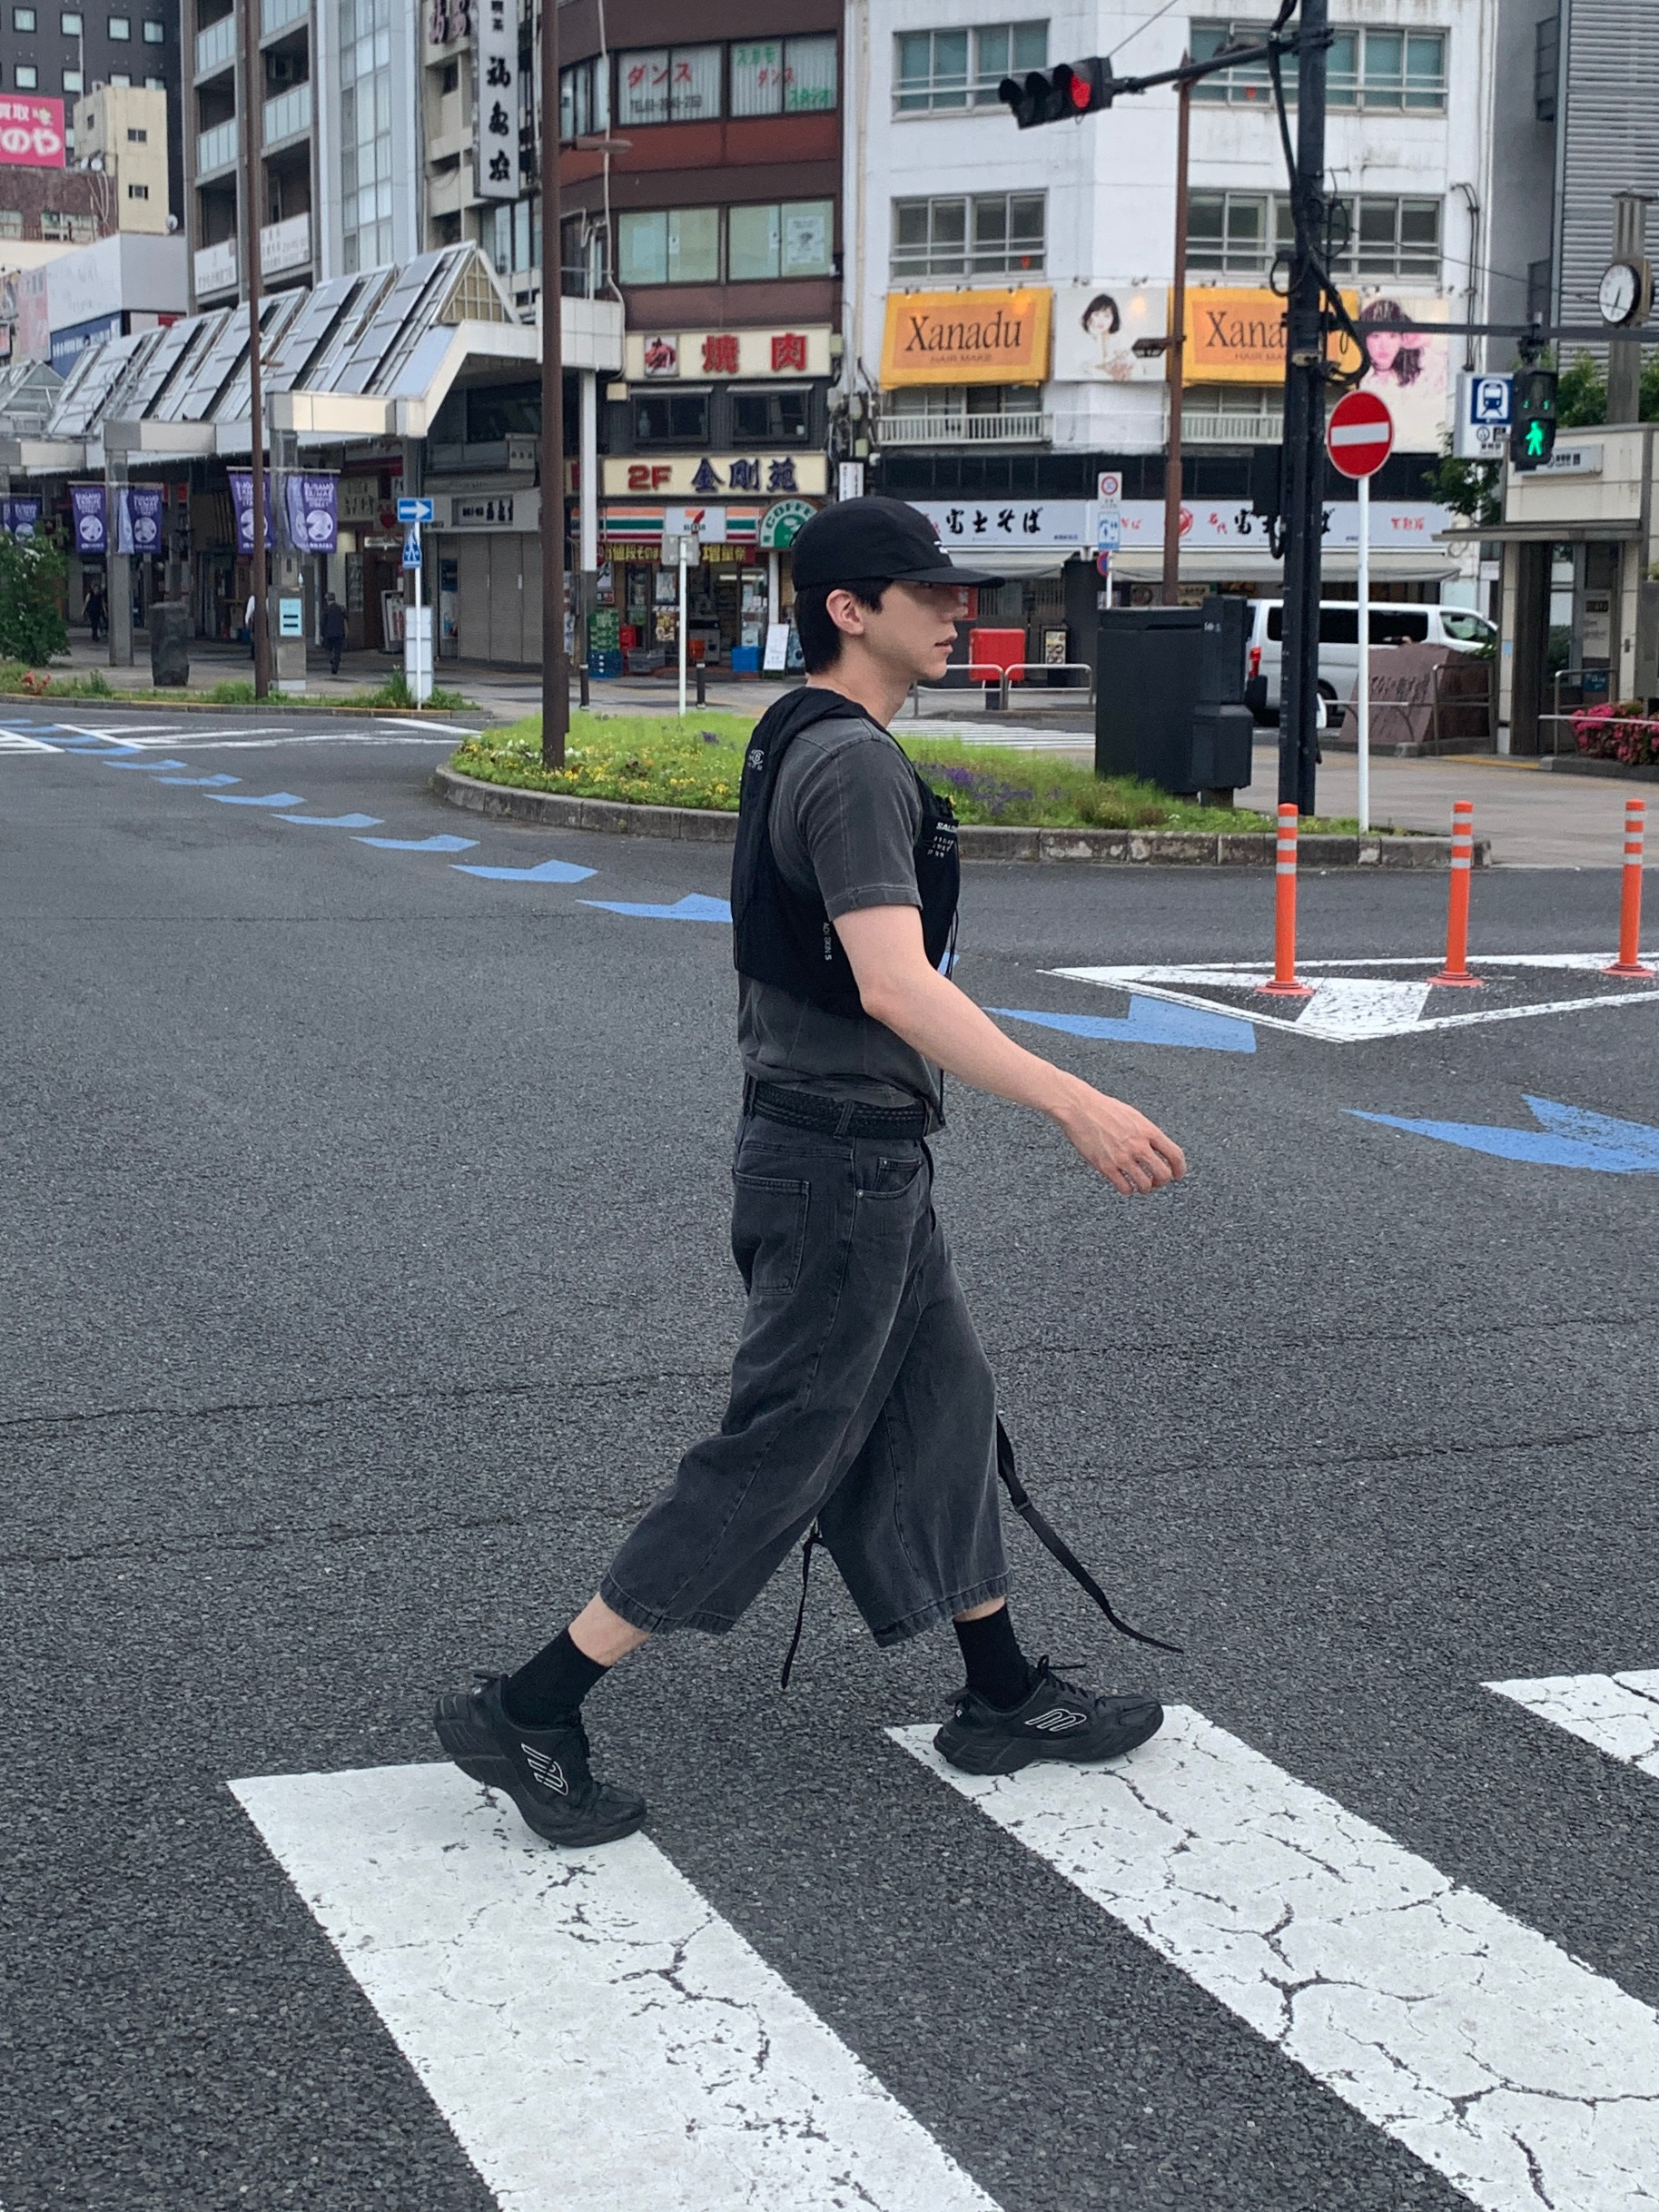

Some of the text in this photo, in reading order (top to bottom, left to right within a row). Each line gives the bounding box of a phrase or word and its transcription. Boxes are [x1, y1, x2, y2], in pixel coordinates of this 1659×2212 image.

[628, 62, 692, 88] ダンス
[905, 310, 1022, 351] Xanadu
[1205, 311, 1286, 349] Xana
[701, 332, 807, 374] 焼肉
[931, 352, 992, 363] HAIR MAKE
[627, 458, 798, 493] 2F 金剛苑
[945, 506, 1043, 535] 富士そば
